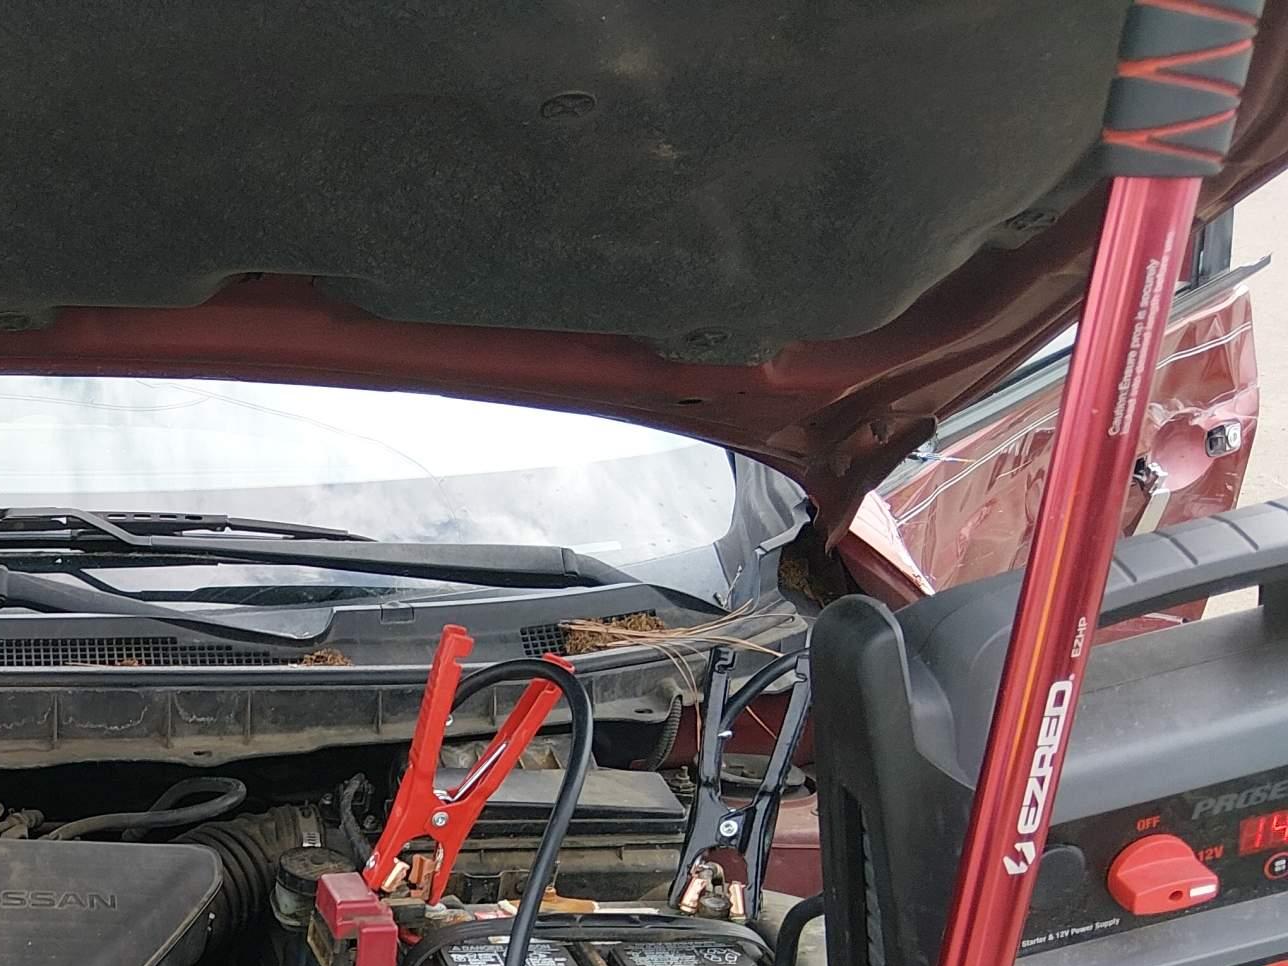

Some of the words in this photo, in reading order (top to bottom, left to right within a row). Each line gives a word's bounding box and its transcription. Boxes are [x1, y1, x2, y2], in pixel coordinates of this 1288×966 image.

[1070, 616, 1089, 658] EZHP
[1017, 680, 1073, 834] EZRED
[1136, 815, 1161, 832] OFF
[1198, 845, 1225, 861] 12V
[1021, 936, 1047, 948] Starter
[1056, 929, 1070, 940] 12V
[1070, 924, 1094, 936] Power
[1094, 917, 1121, 931] Supply
